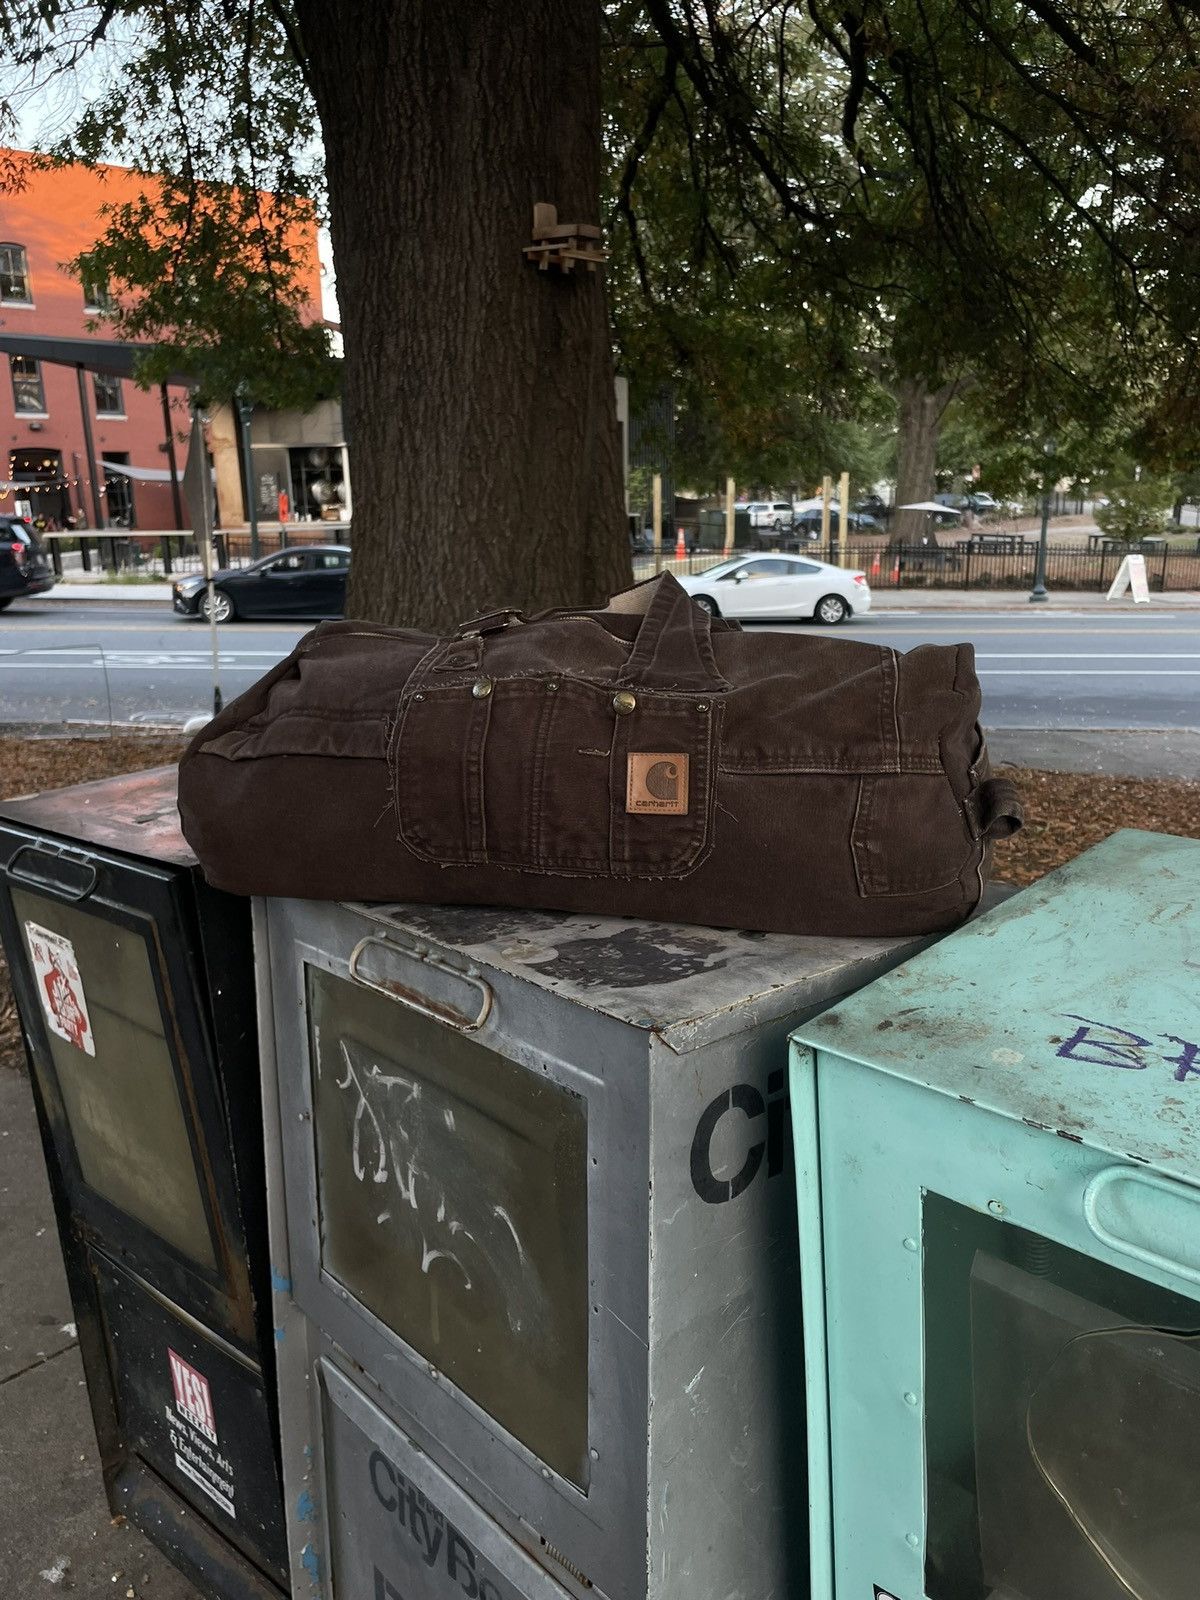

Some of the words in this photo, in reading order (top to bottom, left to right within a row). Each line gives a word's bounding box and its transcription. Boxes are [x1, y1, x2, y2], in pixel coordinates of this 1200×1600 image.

[690, 1067, 790, 1204] Ci
[170, 1355, 214, 1430] YES!
[216, 1452, 234, 1476] Arts
